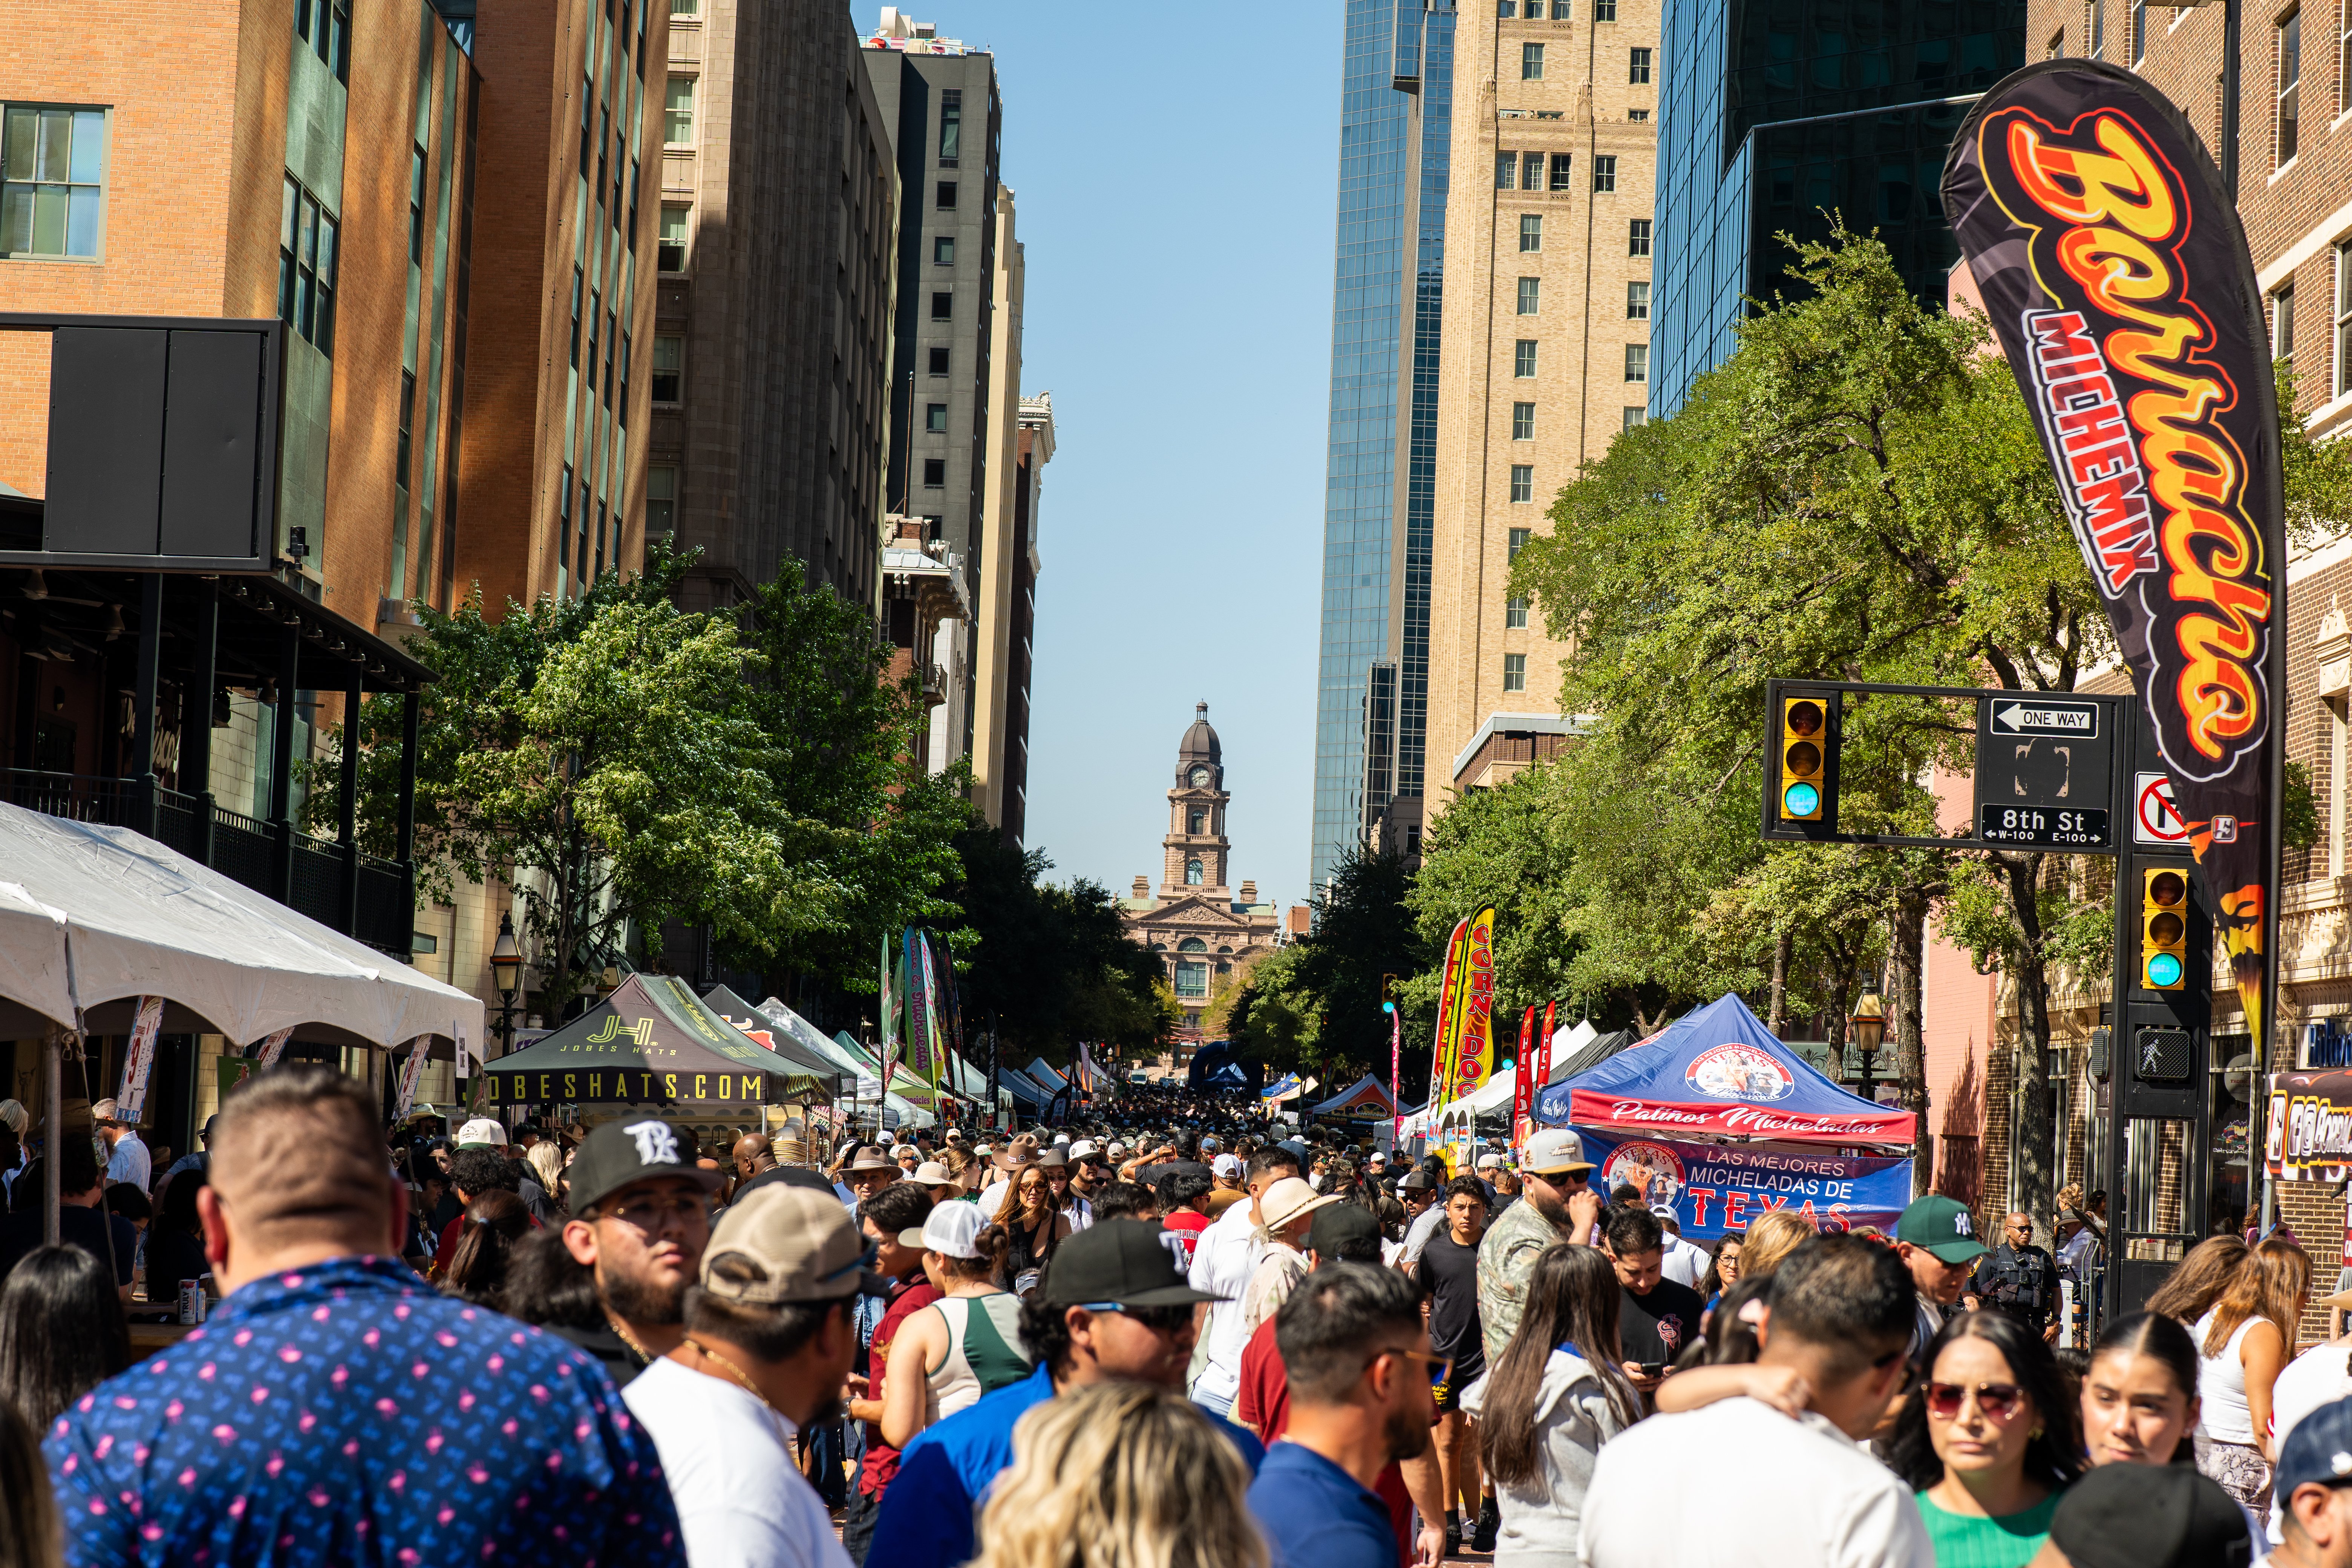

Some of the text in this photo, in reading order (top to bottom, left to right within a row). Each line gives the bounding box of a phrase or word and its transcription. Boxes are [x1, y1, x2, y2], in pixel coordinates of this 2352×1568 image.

[2006, 114, 2272, 763] Borracho
[2034, 312, 2157, 593] MICHEMIX
[2024, 712, 2086, 726] ONE WAY
[2003, 810, 2084, 831] 8th St
[1998, 830, 2086, 842] W-100 E-100
[911, 974, 921, 988] &
[1456, 923, 1493, 1099] CORN DOG
[633, 1047, 677, 1056] HATS
[1694, 1045, 1782, 1069] LAS MEJORES MICHELADAS DE
[1707, 1050, 1769, 1067] TEXAS
[462, 1073, 761, 1101] OBESHATS.COM
[1611, 1100, 1885, 1134] Patiños Micheladas
[1610, 1150, 1619, 1159] LAS
[1619, 1142, 1643, 1151] MEJORES
[1644, 1143, 1675, 1157] MICHELADAS
[1620, 1147, 1670, 1165] TEXAS
[1707, 1150, 1845, 1176] LAS MEJORES
[1690, 1167, 1853, 1199] MICHELADAS DE
[1688, 1187, 1851, 1233] TEXAS
